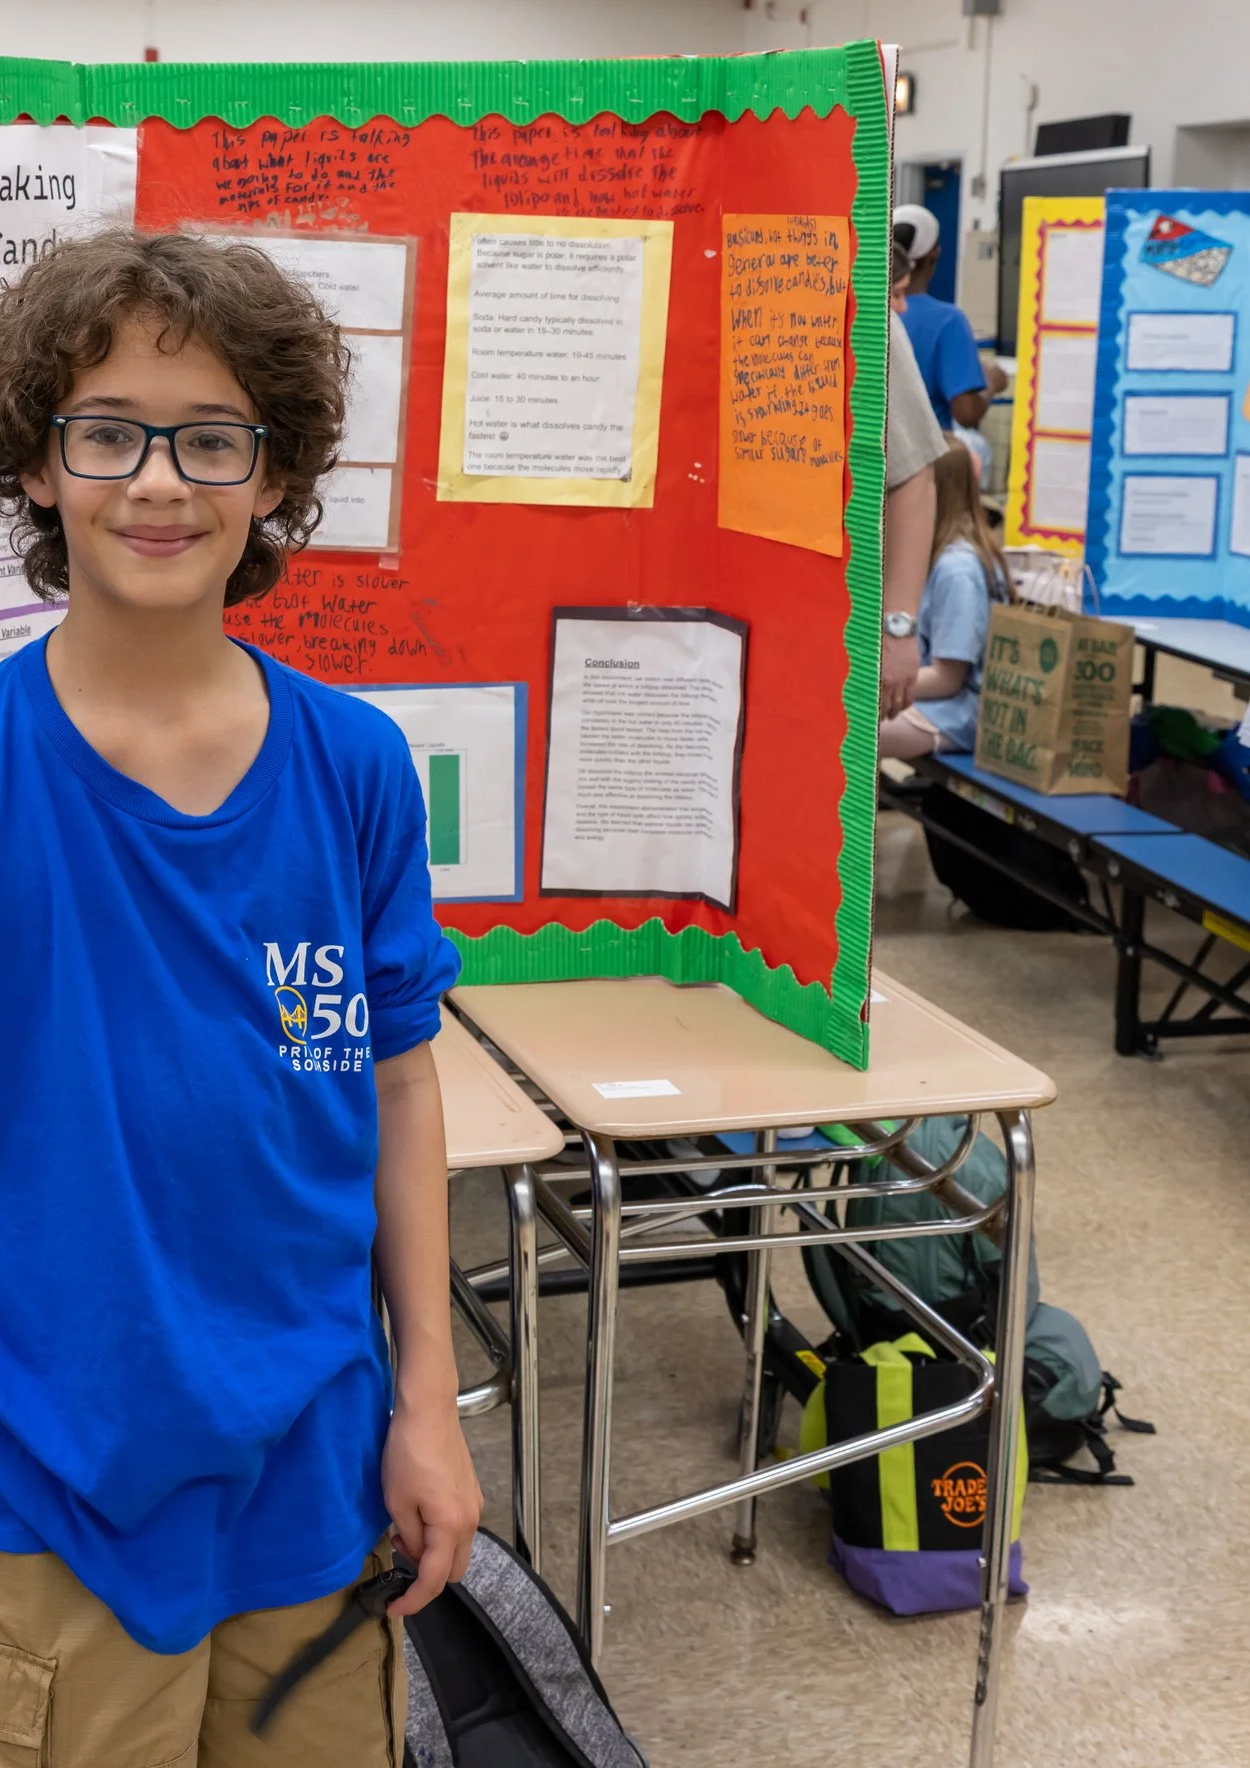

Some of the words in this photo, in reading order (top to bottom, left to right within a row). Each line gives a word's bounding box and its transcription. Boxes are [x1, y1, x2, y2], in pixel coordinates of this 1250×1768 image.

[512, 251, 535, 260] sugar
[576, 253, 607, 263] requires
[544, 263, 553, 271] to
[474, 290, 507, 300] Average
[508, 292, 538, 300] amount
[540, 291, 549, 300] of
[549, 292, 567, 301] time
[568, 292, 579, 301] for
[498, 314, 517, 322] Hard
[519, 315, 543, 325] candy
[472, 325, 492, 333] soda
[504, 326, 526, 334] water
[527, 326, 535, 334] in
[516, 372, 526, 381] 40
[527, 373, 558, 381] minutes
[560, 374, 569, 382] to
[494, 395, 504, 403] 15
[516, 395, 526, 404] 30
[469, 419, 484, 428] Hot
[510, 420, 518, 428] is
[519, 421, 540, 429] what
[542, 421, 581, 431] dissolves
[610, 423, 624, 432] the
[468, 451, 483, 459] The
[505, 453, 552, 462] temperature
[554, 453, 576, 461] water
[609, 455, 626, 463] best
[484, 463, 516, 471] because
[532, 464, 572, 473] molecules
[332, 573, 345, 587] is
[356, 575, 410, 590] slower
[261, 613, 286, 630] the
[299, 611, 389, 634] molecules
[0, 625, 31, 640] Variable
[303, 632, 377, 655] breaking
[388, 639, 428, 657] down
[990, 635, 1020, 665] IT'S
[585, 658, 640, 669] Conclusion
[986, 666, 1046, 705] WHAT'S
[1009, 707, 1029, 735] IN
[263, 942, 344, 987] MS
[311, 993, 369, 1040] 50
[314, 1047, 332, 1059] OF
[344, 1046, 370, 1059] THE
[941, 1496, 986, 1512] JOE'S
